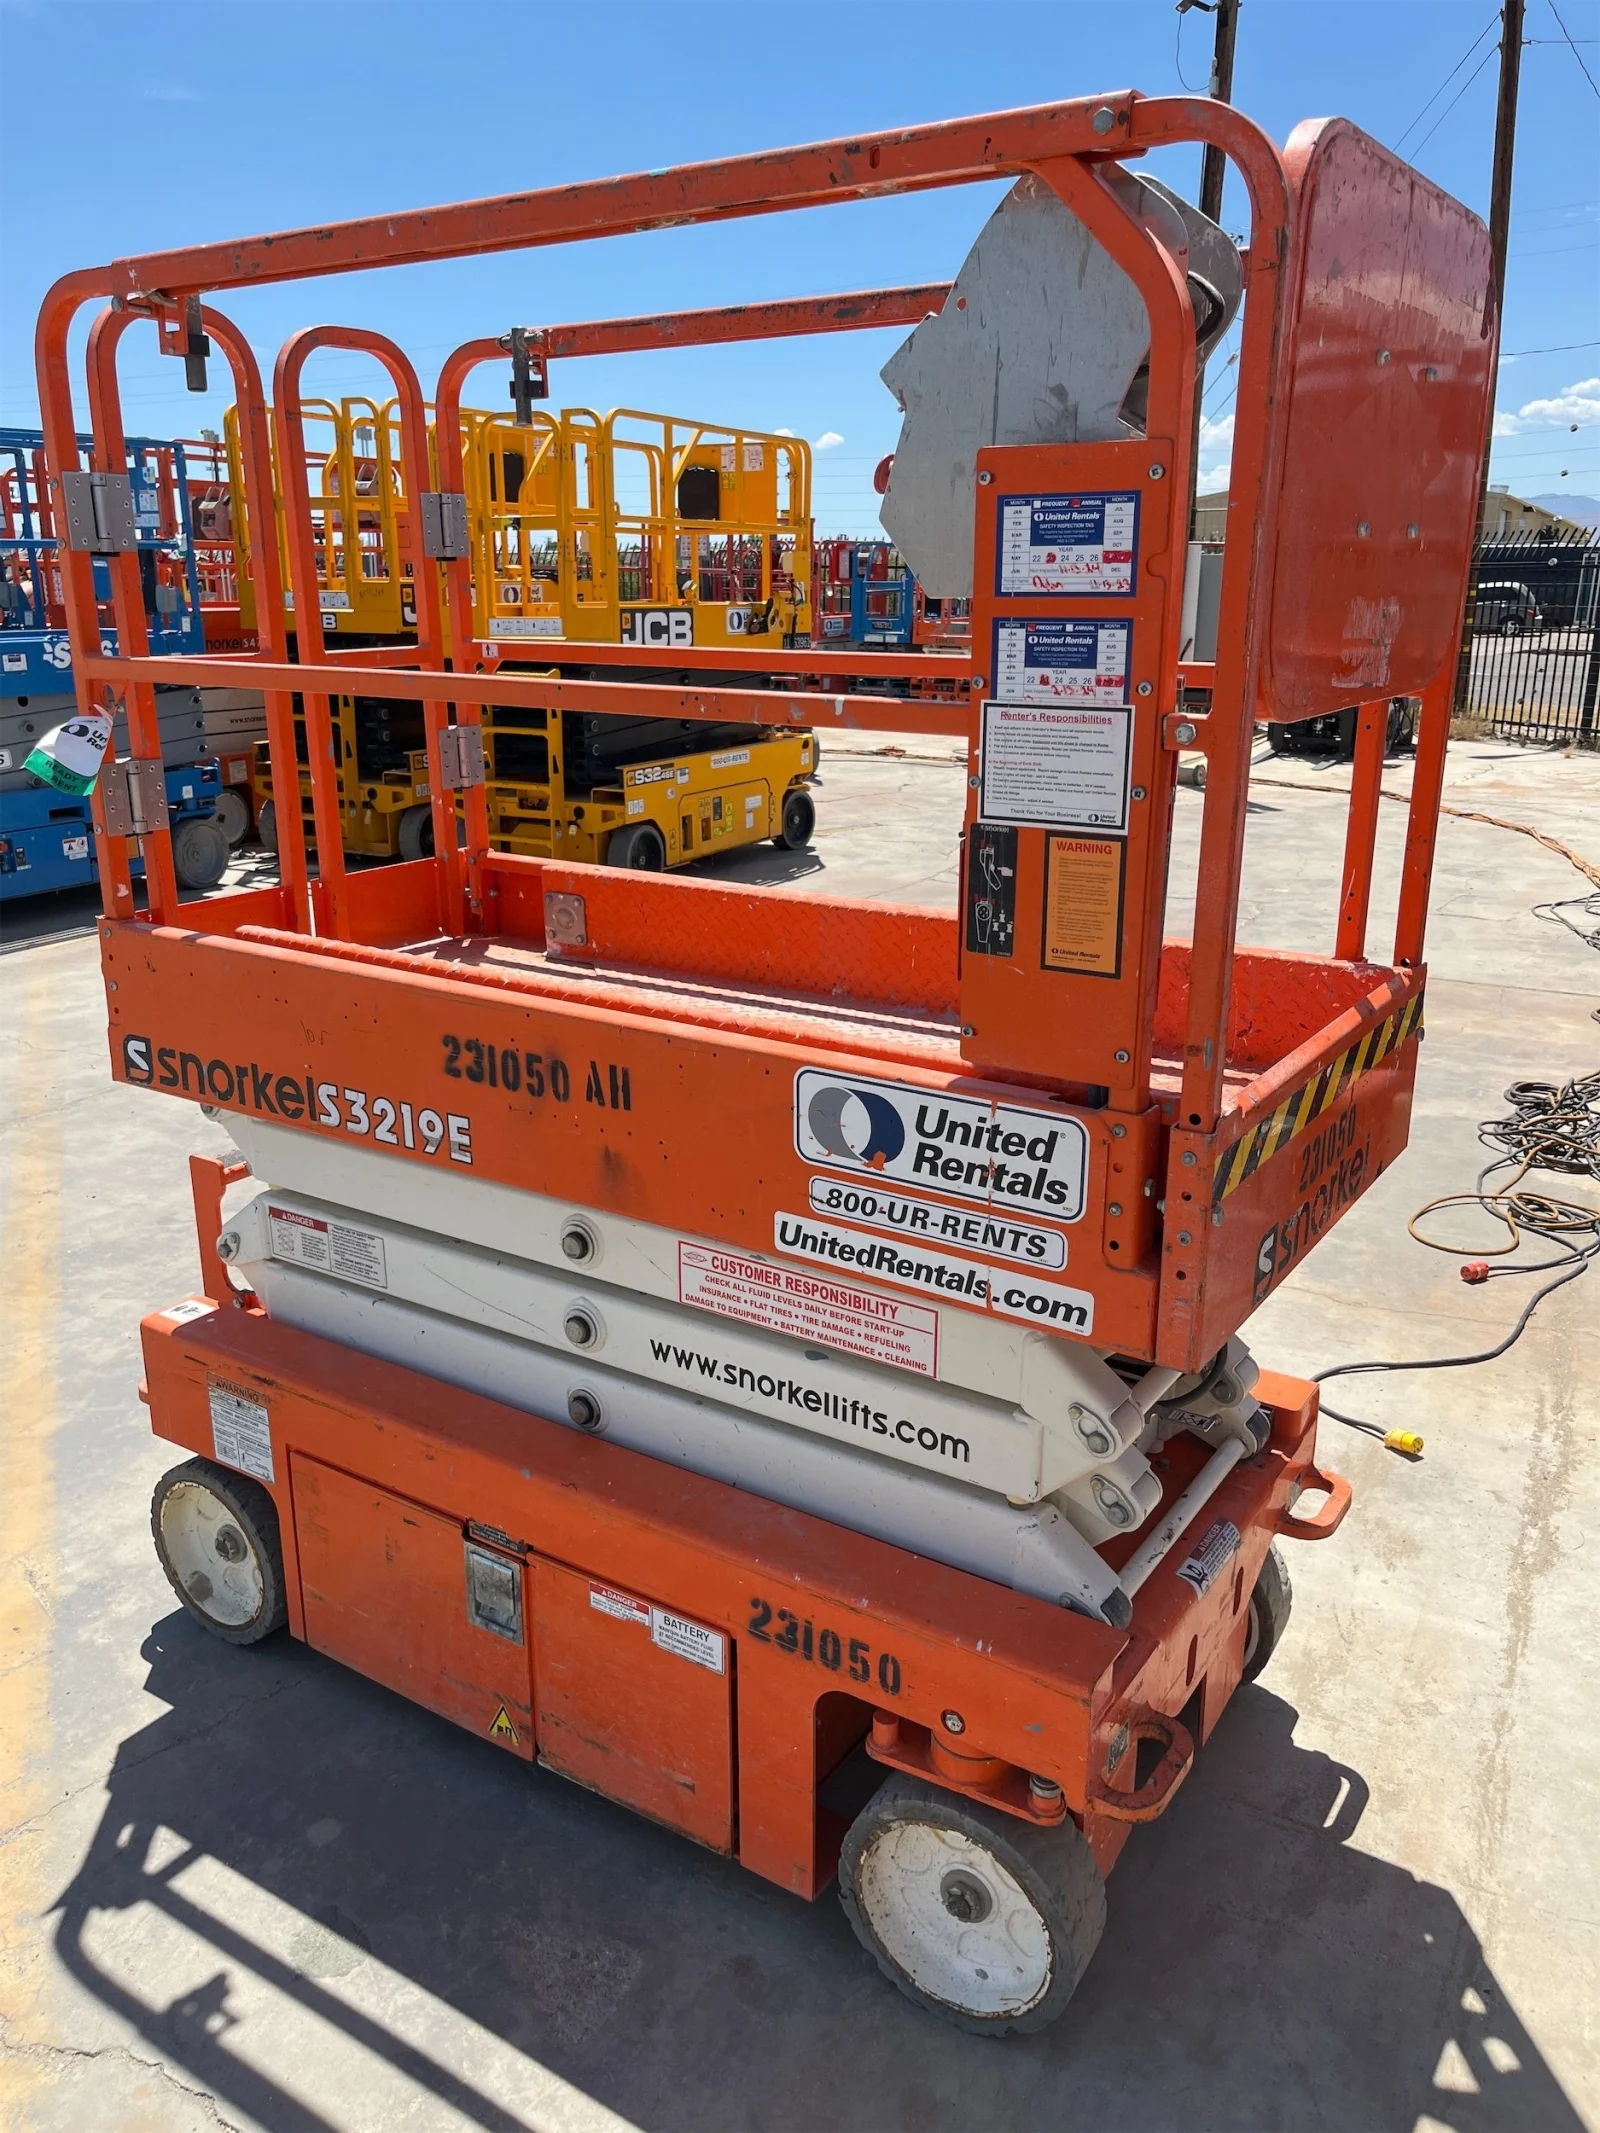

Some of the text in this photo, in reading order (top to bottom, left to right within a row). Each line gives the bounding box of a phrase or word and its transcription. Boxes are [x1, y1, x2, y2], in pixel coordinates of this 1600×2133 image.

[1044, 511, 1100, 521] United Rentals
[1075, 554, 1085, 562] 25
[622, 610, 692, 647] JCB
[1039, 636, 1093, 645] United Rentals
[1083, 677, 1092, 685] 26
[1001, 711, 1113, 724] Renter's Responsibilities
[45, 760, 78, 782] READY
[51, 775, 78, 792] RENT
[1056, 841, 1112, 855] WARNING
[1059, 948, 1100, 959] United Rentals
[442, 1034, 570, 1103] 231050
[158, 1046, 475, 1166] snorkel S3219E
[914, 1104, 1060, 1164] United
[1299, 1103, 1357, 1192] 231050
[912, 1142, 1069, 1205] Rentals
[1277, 1133, 1371, 1273] snorkel
[286, 1212, 315, 1227] DANGER
[825, 1187, 1048, 1258] 800-UR-RENTS
[778, 1219, 1088, 1328] UnitedRentals.com
[711, 1255, 899, 1320] CUSTOMER RESPONSIBILITY
[699, 1285, 911, 1353] INSURANCE FLAT TIRES TIRE DAMAGE REFUELING
[705, 1274, 905, 1338] CHECK ALL FLUID LEVELS DAILY BEFORE START-UP
[685, 1293, 927, 1371] DAMAGE TO EQUIPMENT BATTERY MAINTENANCE CLEANING
[220, 1381, 260, 1403] WARNING
[649, 1338, 971, 1463] www.snorkellifts.com
[1202, 1524, 1222, 1548] DANGER
[607, 1591, 638, 1609] DANGER
[663, 1615, 710, 1642] BATTERY
[680, 1632, 700, 1647] BATTERY
[700, 1641, 714, 1652] FLUID
[665, 1633, 700, 1653] RECOMMENDED
[700, 1648, 714, 1659] LEVEL
[747, 1597, 902, 1695] 231050
